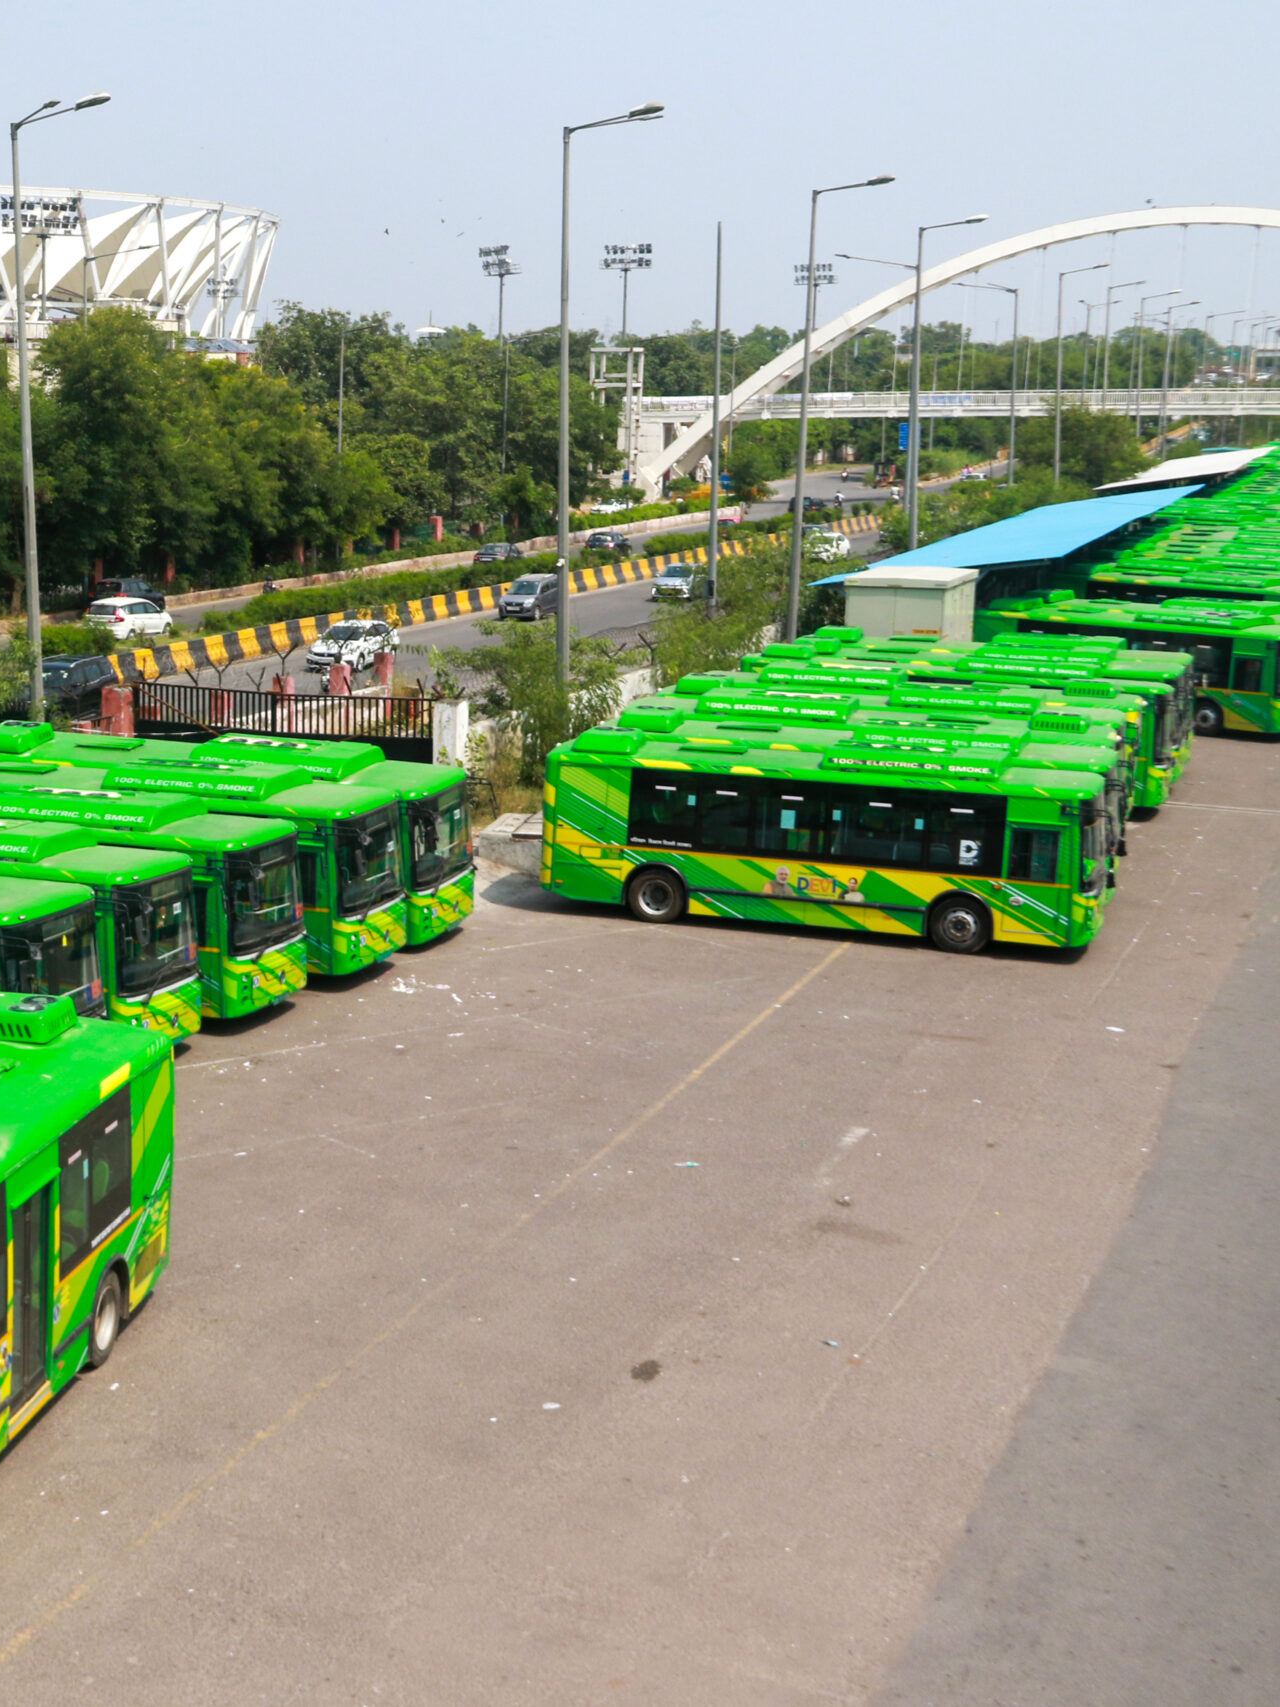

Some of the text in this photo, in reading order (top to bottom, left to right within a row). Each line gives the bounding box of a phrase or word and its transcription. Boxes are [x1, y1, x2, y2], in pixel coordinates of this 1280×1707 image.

[706, 702, 732, 710] 100%
[734, 703, 780, 713] ELECTRIC.
[800, 708, 838, 717] SMOKE.
[865, 734, 894, 742] 100%
[951, 739, 968, 747] 0%
[831, 757, 863, 766] 100%
[866, 759, 921, 769] ELECTRIC.
[948, 765, 993, 775] SMOKE.
[114, 776, 257, 793] 100% ELECTRIC. 0% SMOKE.
[28, 807, 82, 819] ELECTRIC.
[84, 811, 102, 820] 0%
[103, 812, 146, 824] SMOKE.
